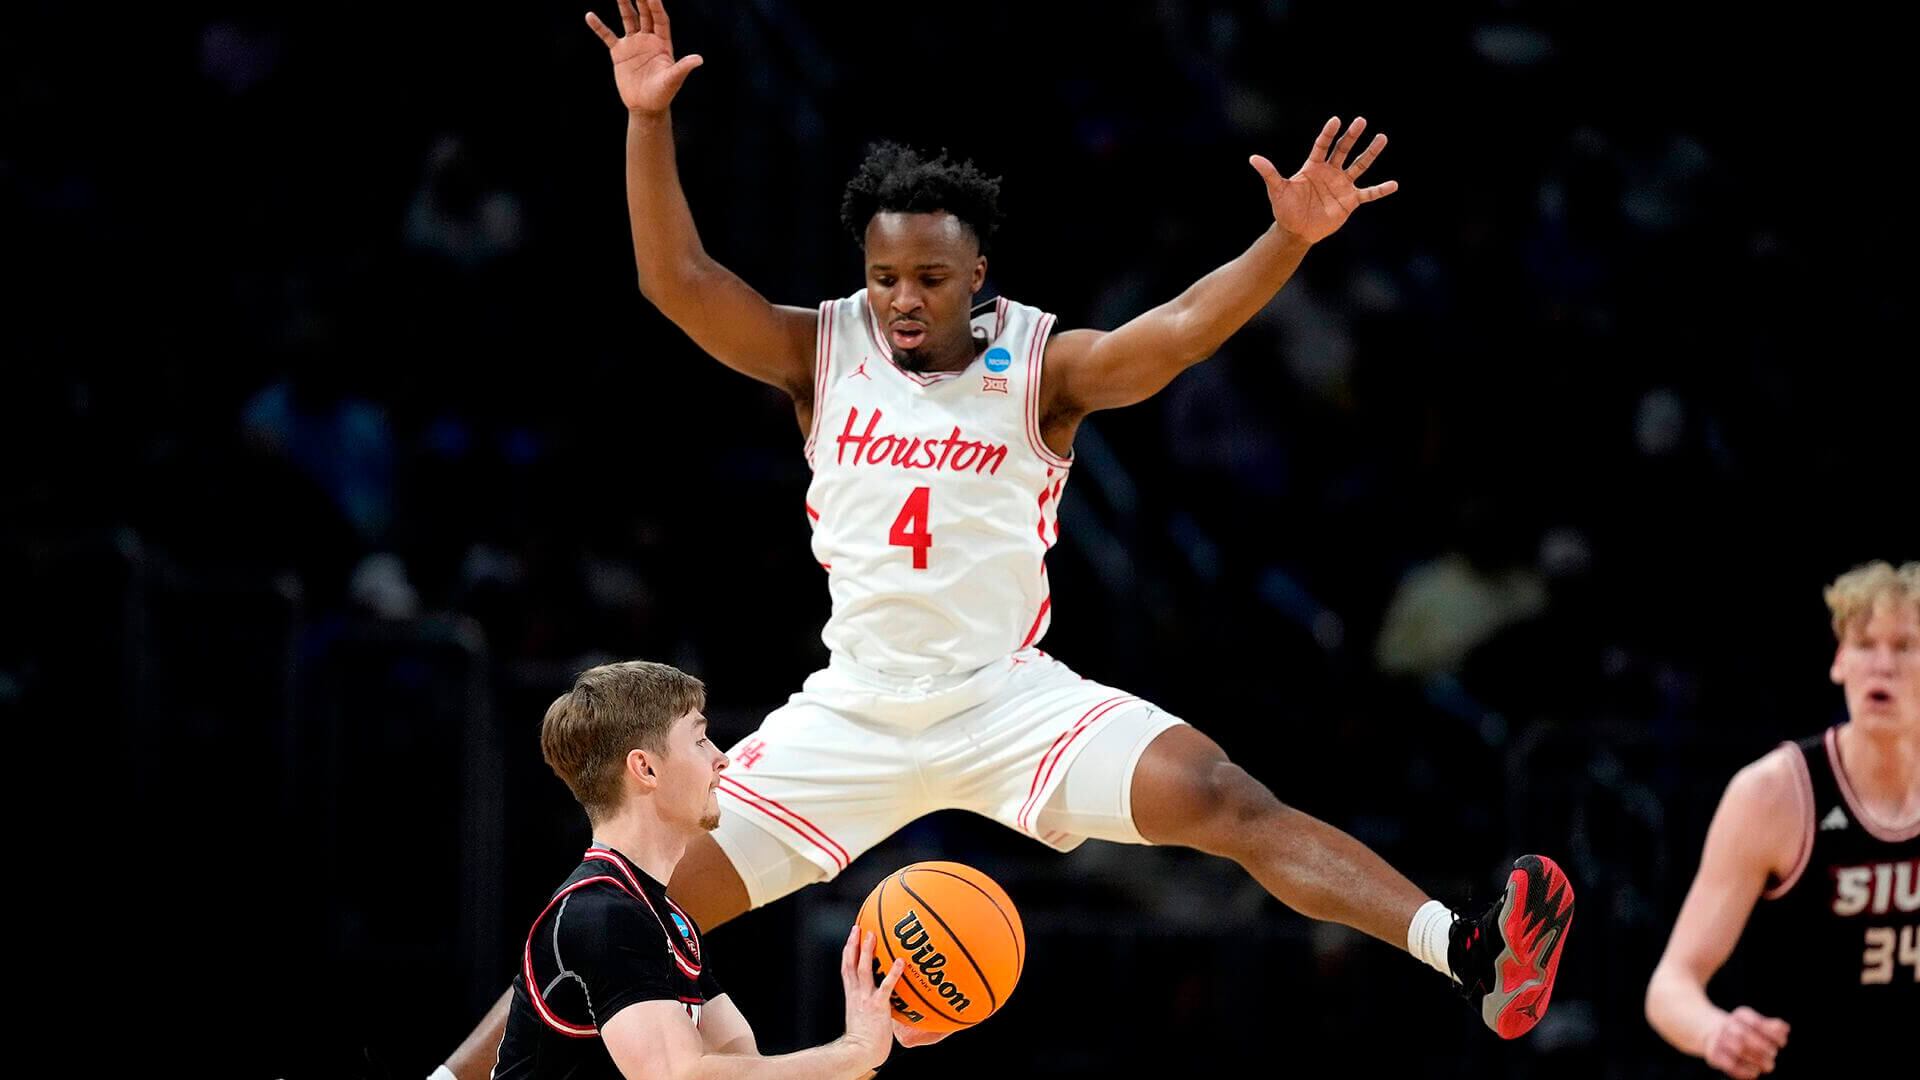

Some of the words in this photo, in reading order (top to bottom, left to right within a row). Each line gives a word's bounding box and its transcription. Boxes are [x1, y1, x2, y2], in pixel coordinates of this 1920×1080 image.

[836, 406, 1008, 475] Houston
[888, 487, 932, 569] 4
[894, 911, 970, 1012] Wilson
[1860, 925, 1920, 985] 34
